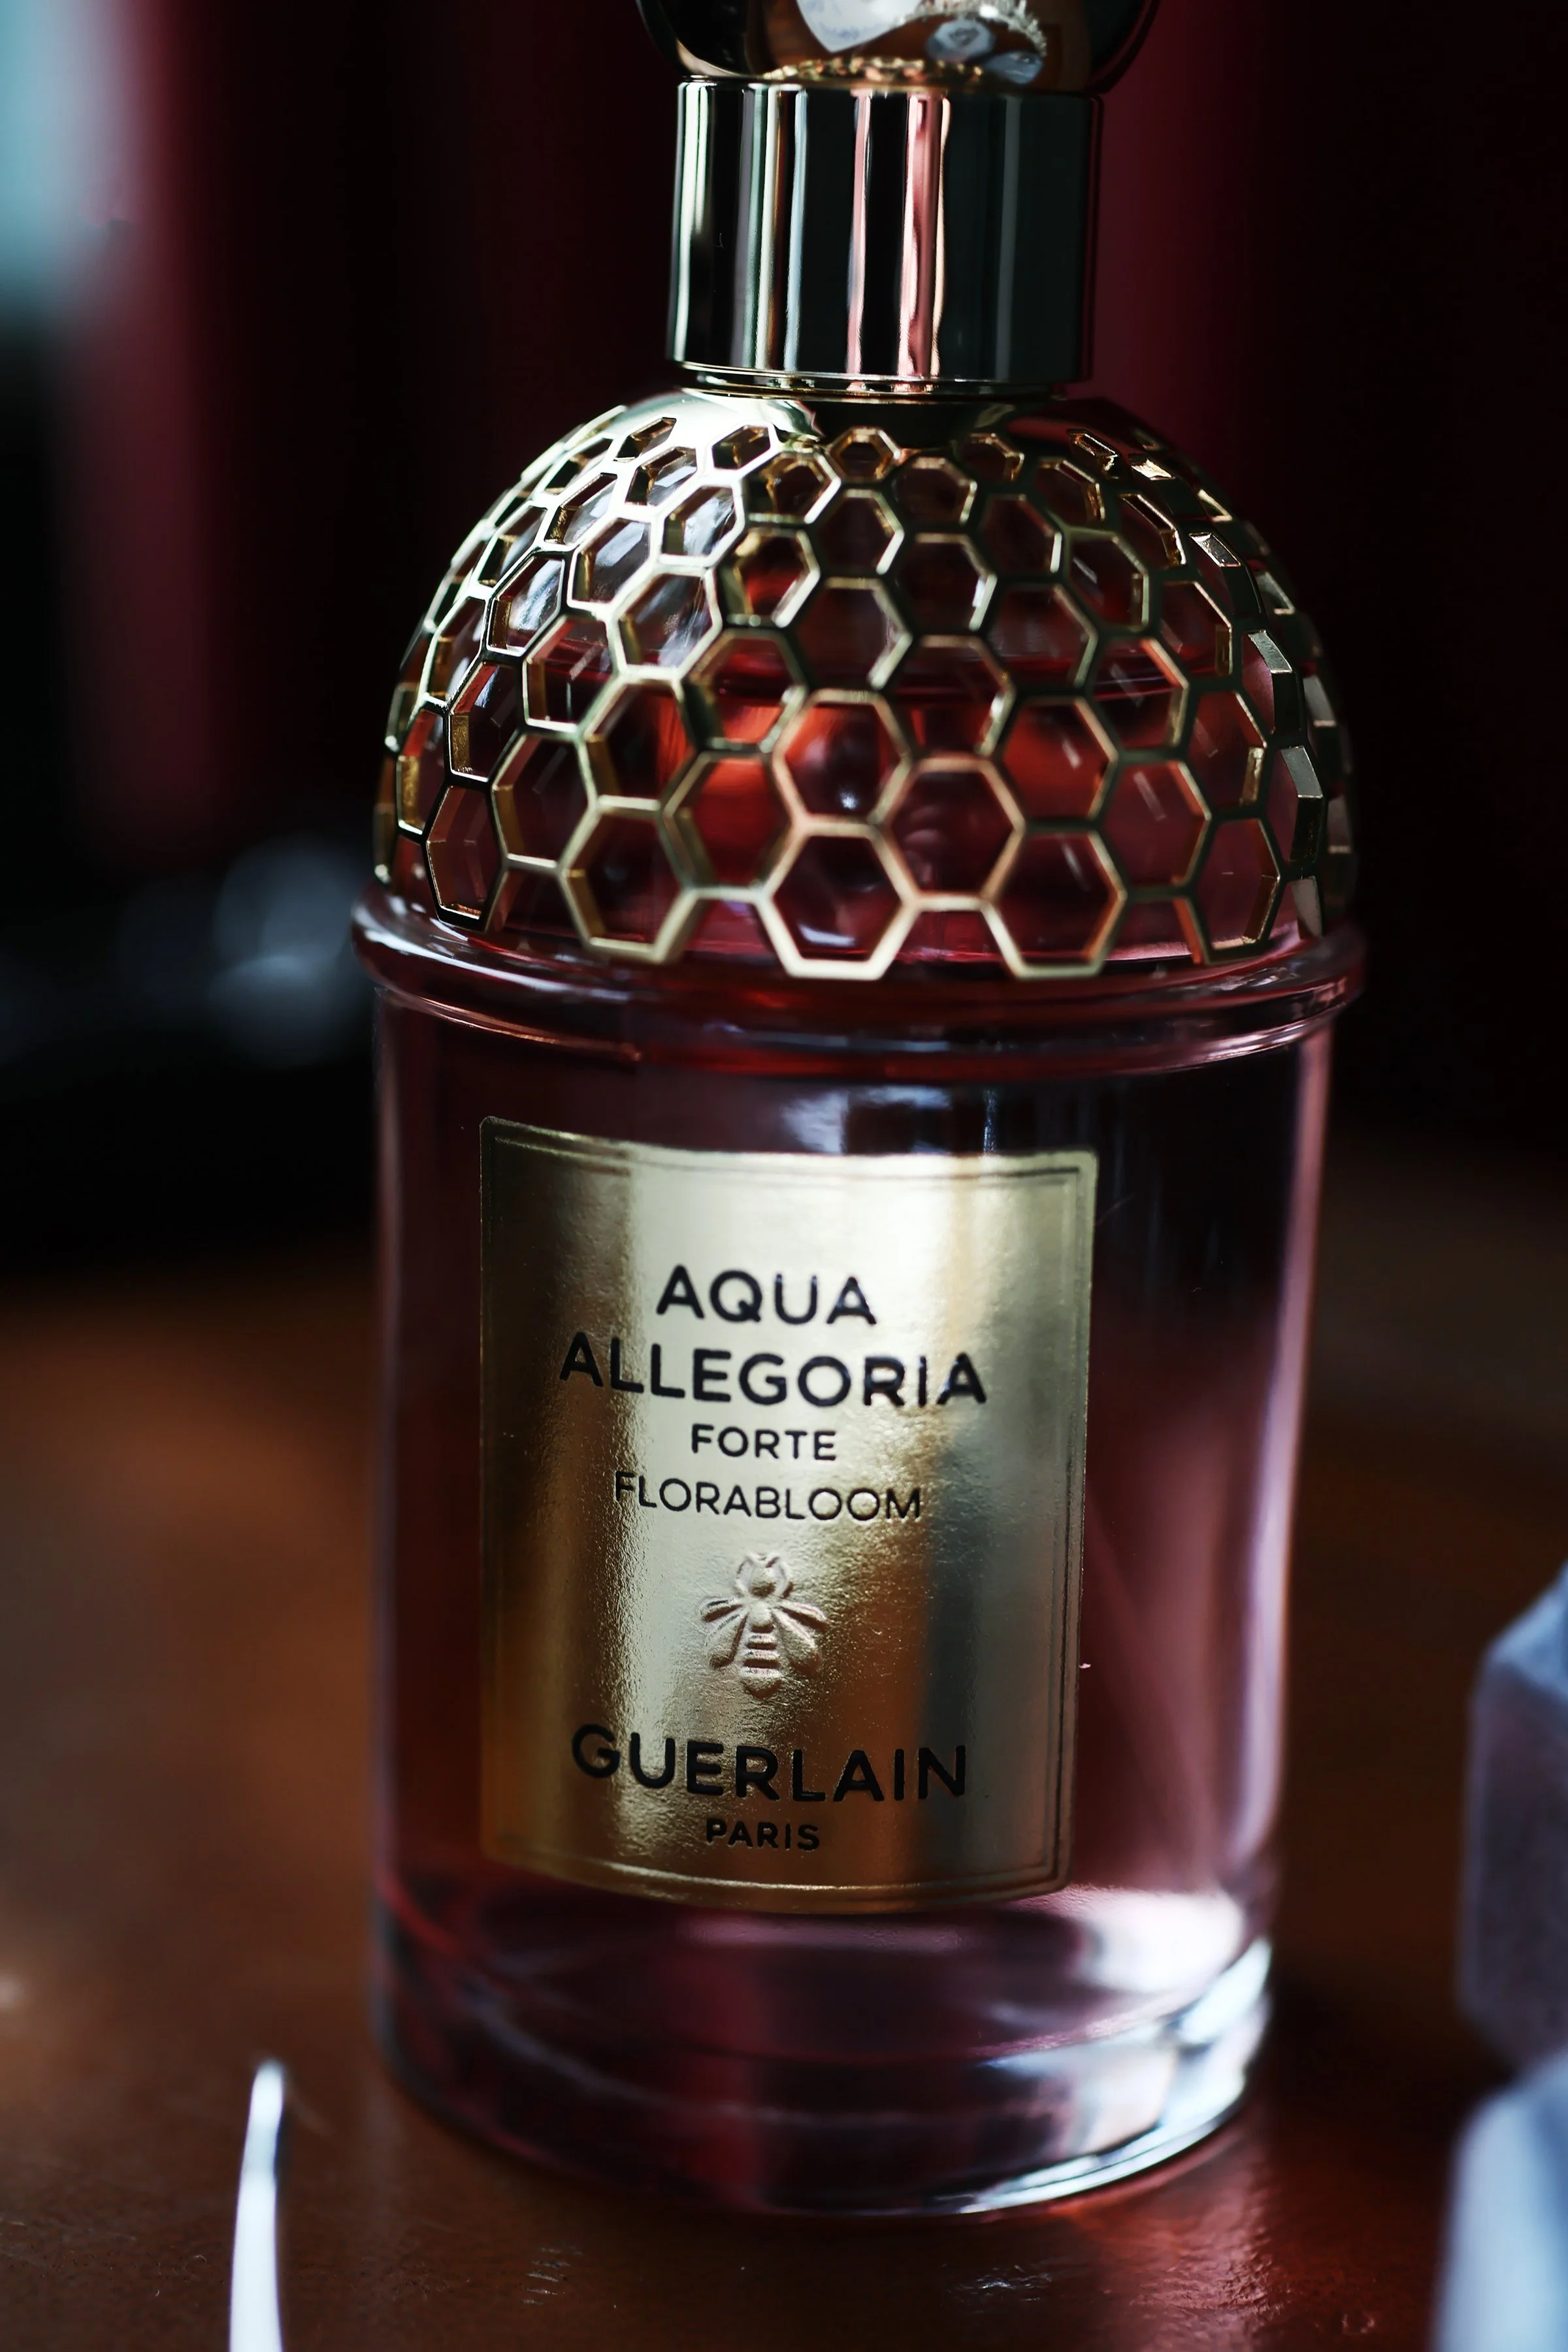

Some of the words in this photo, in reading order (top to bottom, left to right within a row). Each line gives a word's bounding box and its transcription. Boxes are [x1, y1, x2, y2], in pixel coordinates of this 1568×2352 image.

[656, 1264, 877, 1326] AQUA
[559, 1331, 987, 1408] ALLEGORIA
[691, 1423, 837, 1461] FORTE
[615, 1471, 921, 1521] FLORABLOOM
[571, 1723, 966, 1803] GUERLAIN
[706, 1818, 820, 1852] PARIS
